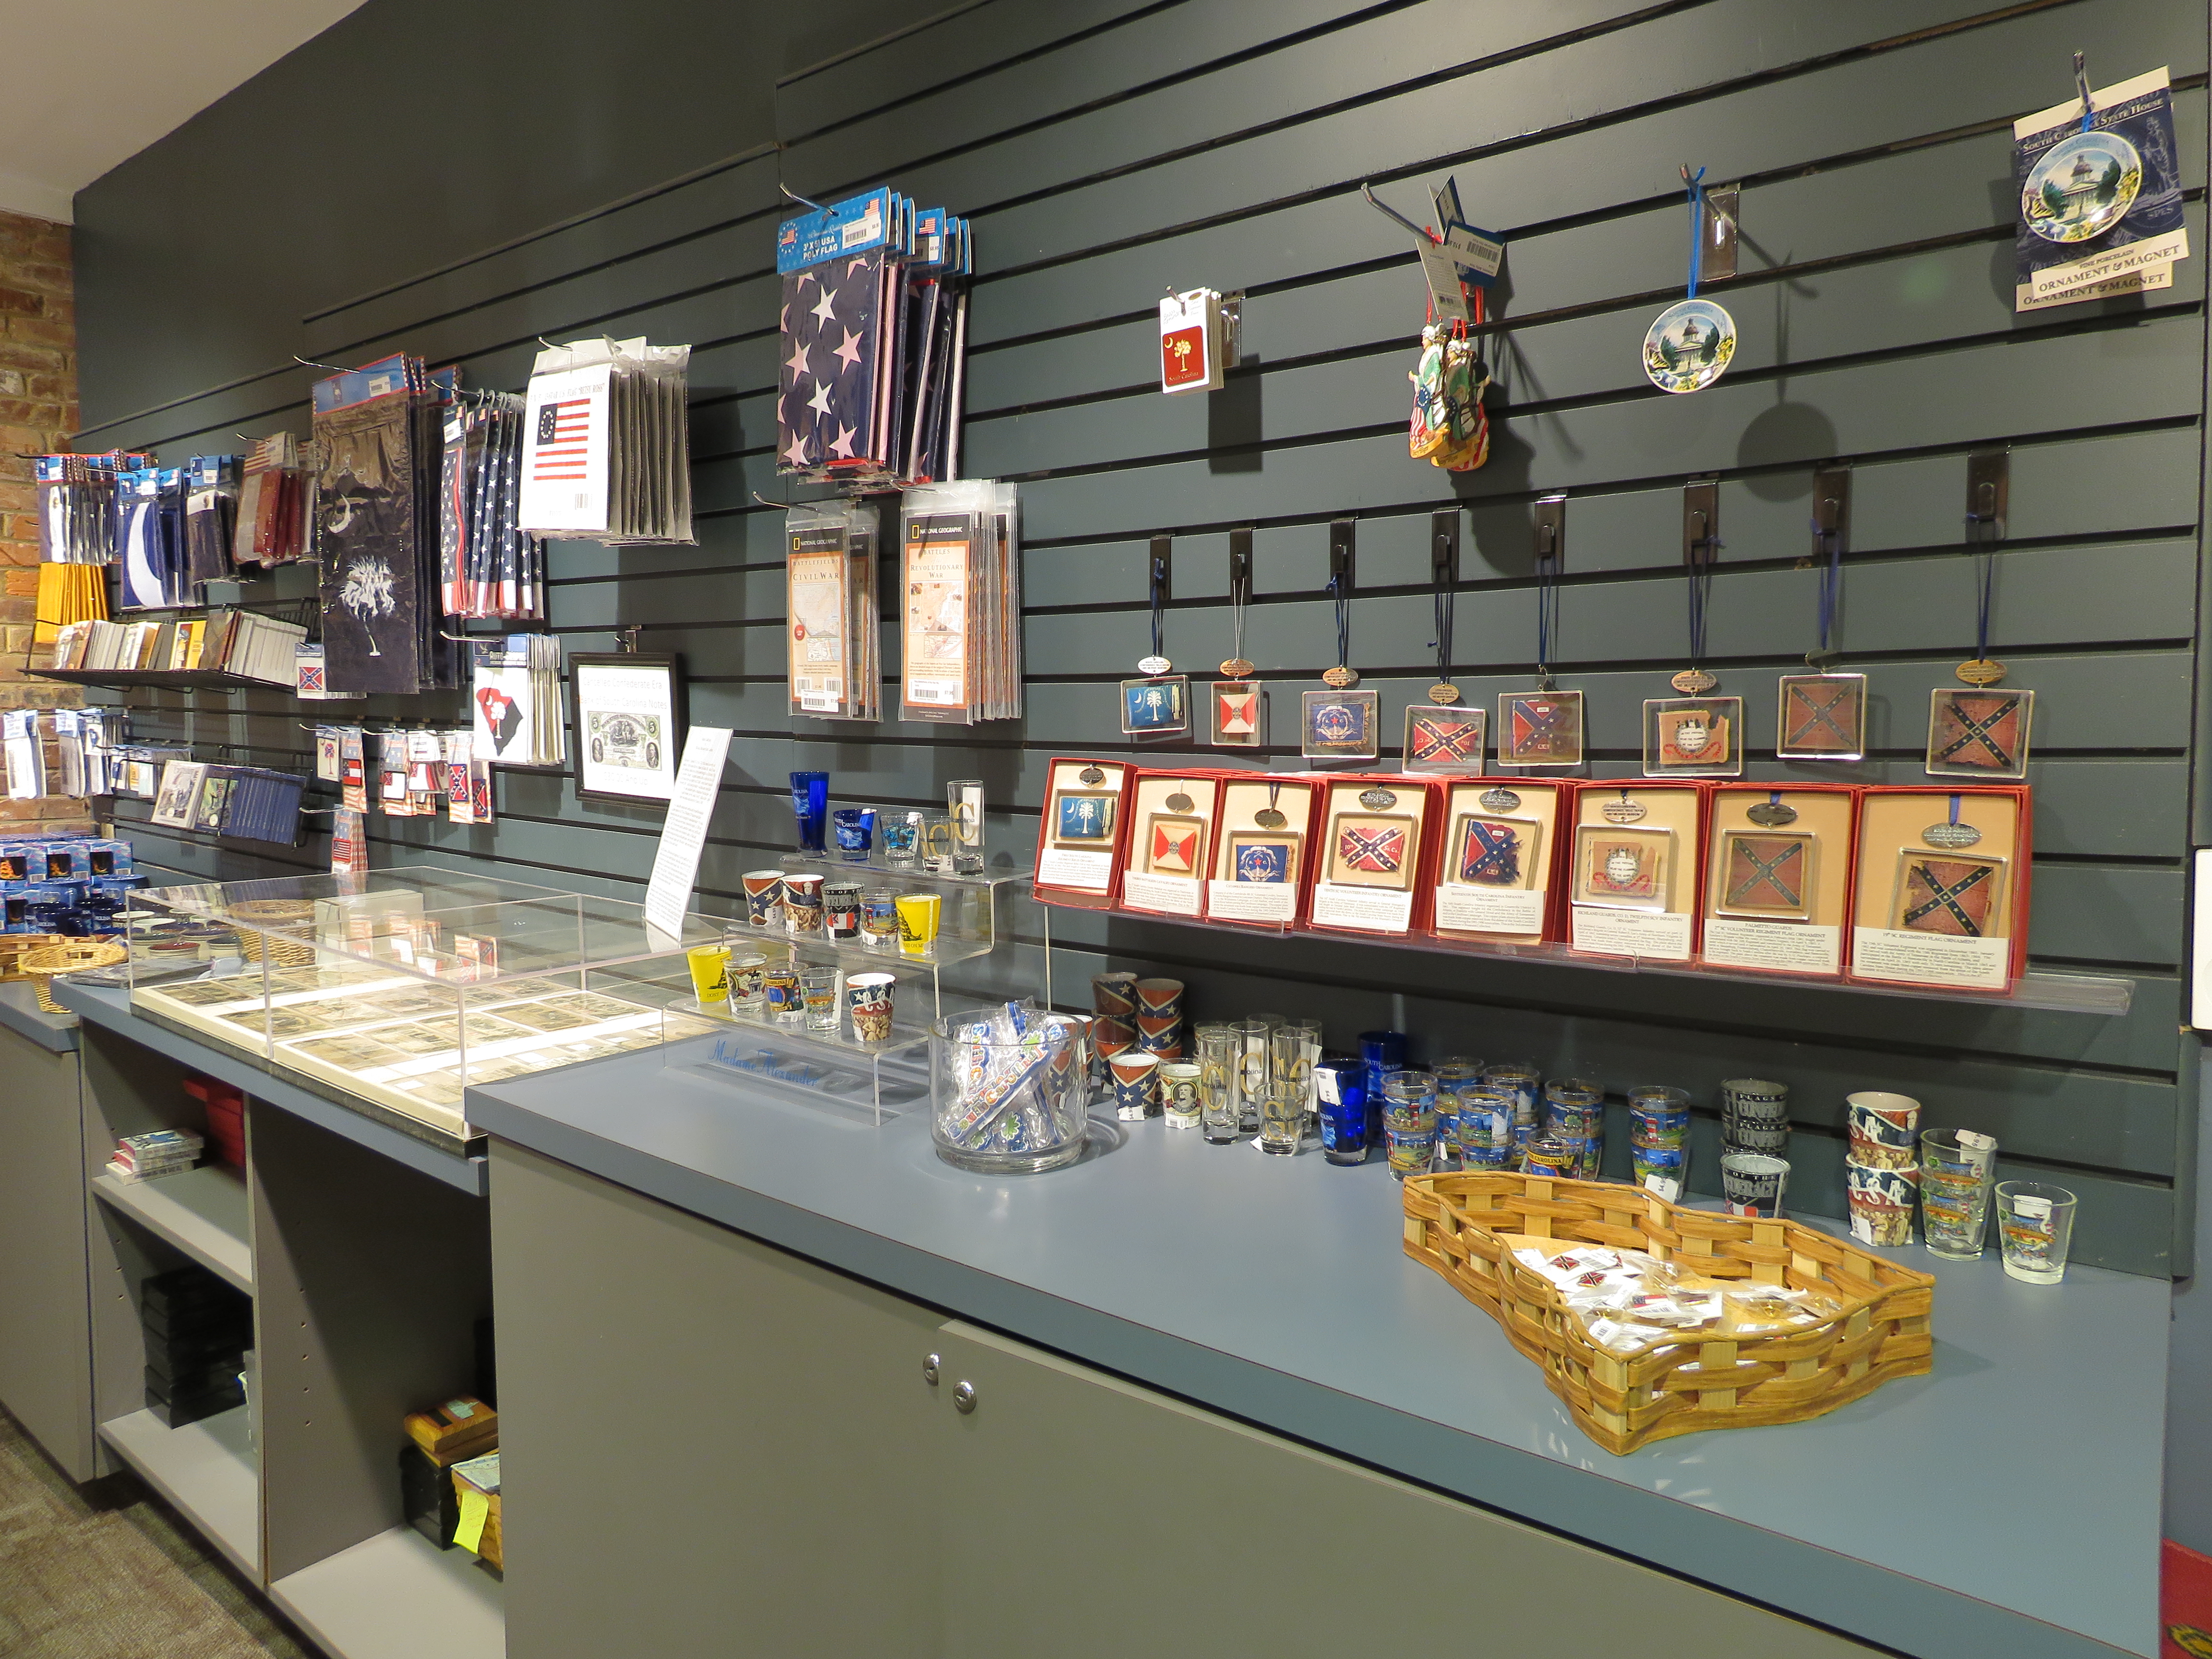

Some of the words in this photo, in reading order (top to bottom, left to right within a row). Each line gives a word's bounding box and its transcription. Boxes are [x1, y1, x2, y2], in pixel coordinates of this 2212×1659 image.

[2100, 111, 2128, 125] STATE
[2131, 98, 2164, 115] HOUSE
[821, 236, 835, 245] USA
[803, 249, 819, 260] POLY
[821, 243, 838, 254] FLAG
[2095, 249, 2134, 264] PORCELAIN
[2039, 266, 2110, 292] ORNAMENT
[2112, 262, 2122, 271] &
[2124, 244, 2180, 269] MAGNET
[2023, 285, 2095, 305] ORNAMENT
[2108, 273, 2165, 290] MAGNET
[583, 677, 611, 686] Cancelled
[613, 678, 650, 688] Confederate
[652, 680, 662, 689] Era
[623, 697, 646, 708] Carolina
[649, 699, 667, 709] Notes
[593, 718, 599, 728] 5
[649, 721, 655, 733] 5
[708, 1039, 757, 1071] Madame
[757, 1049, 821, 1086] Alexander
[1364, 1058, 1381, 1066] SOUTH
[1379, 1063, 1403, 1071] CAROLINA
[1740, 1094, 1776, 1102] FLAGS
[1740, 1122, 1776, 1130] FLAGS
[1534, 1156, 1561, 1164] CAROLINA
